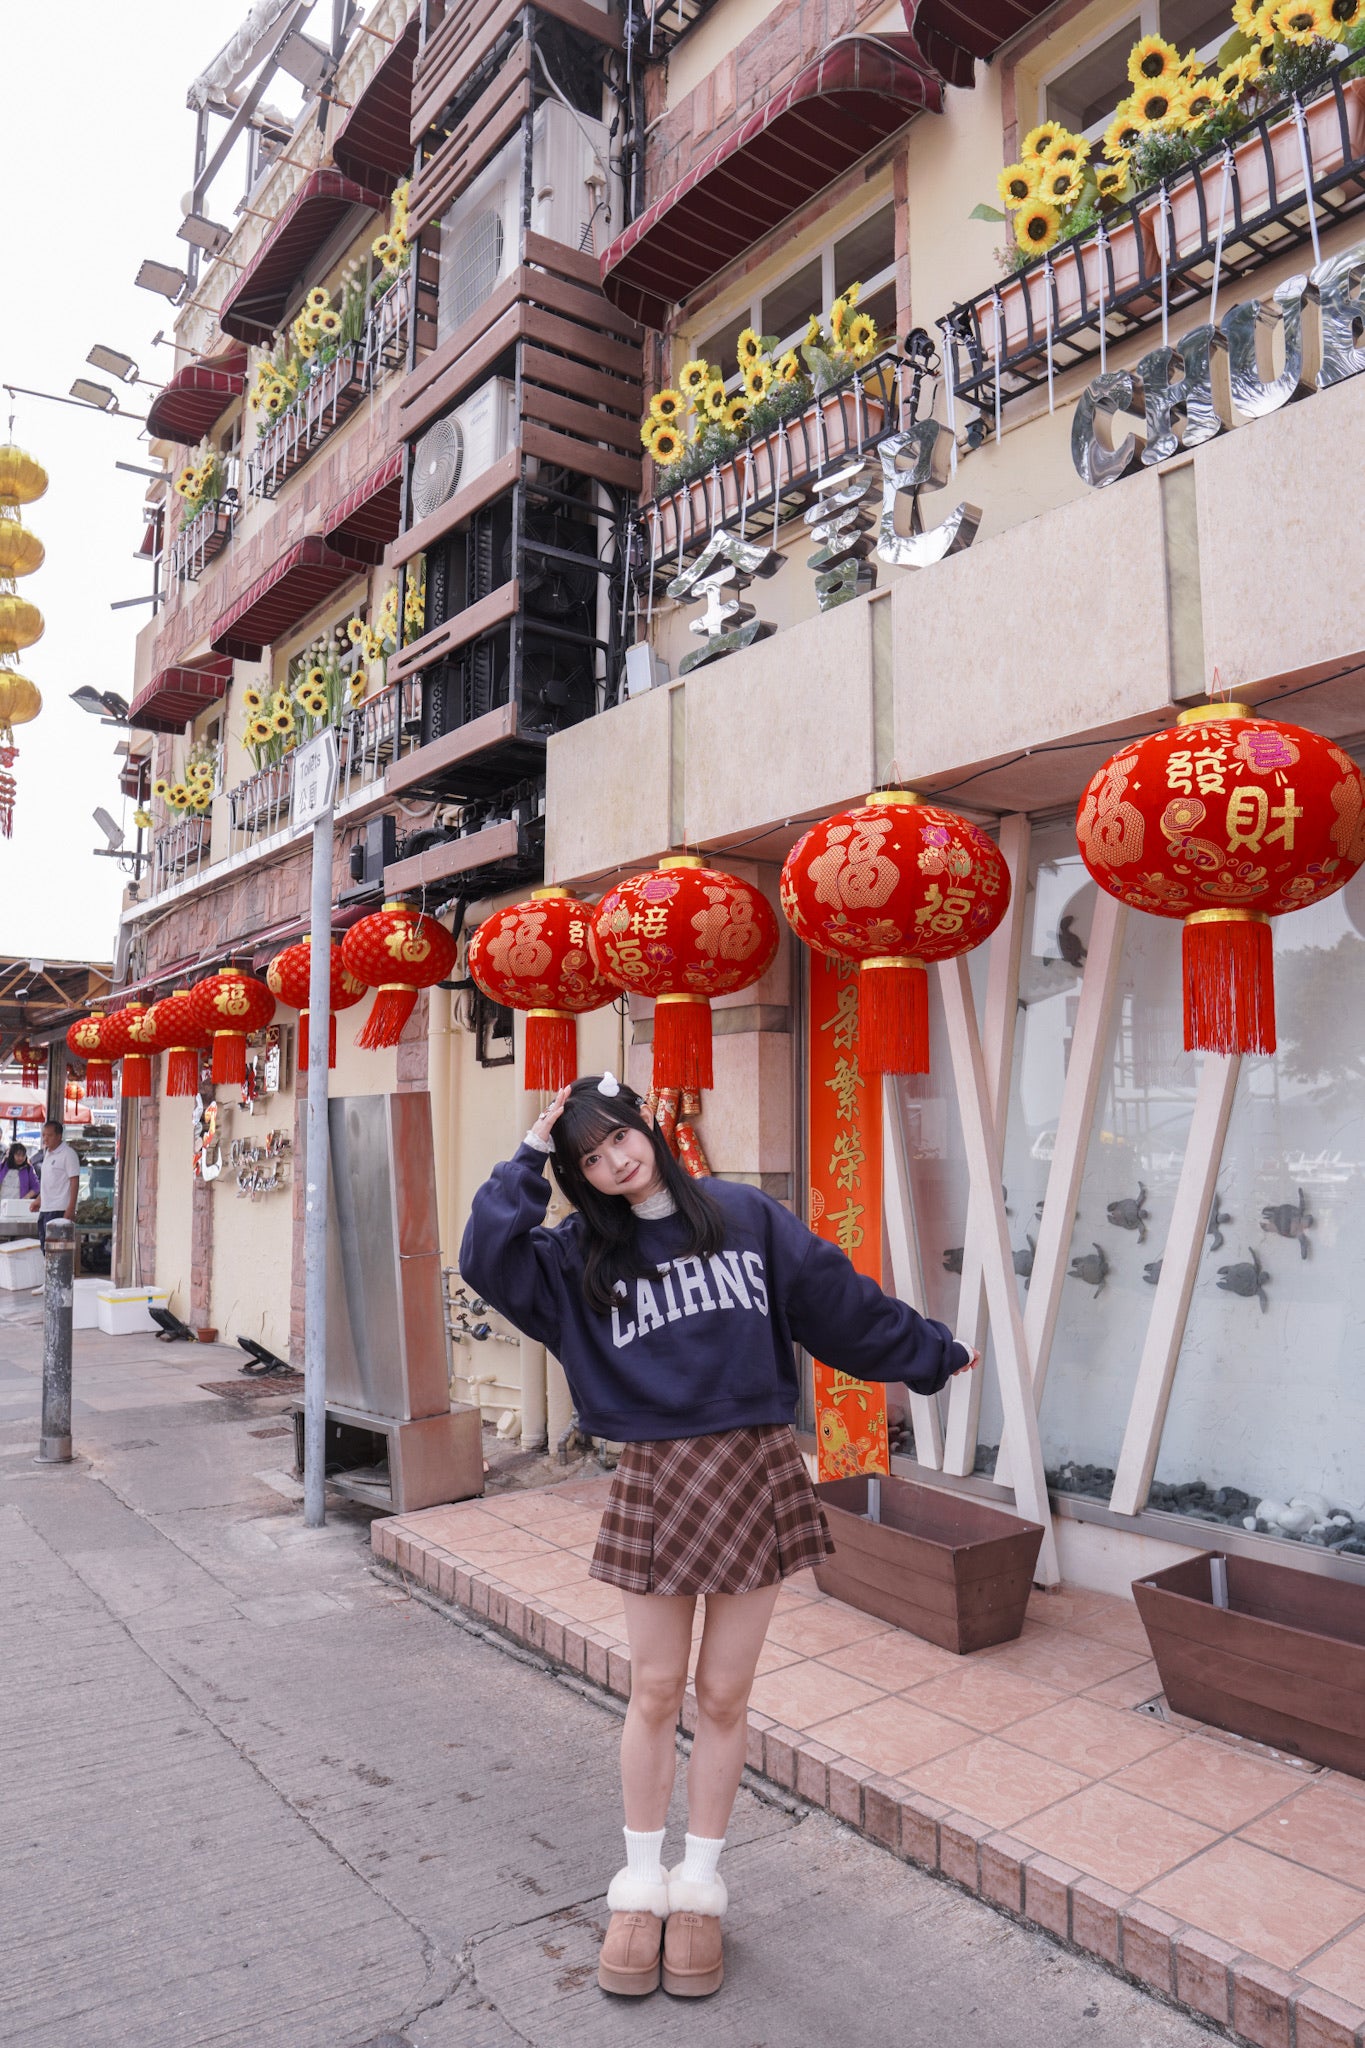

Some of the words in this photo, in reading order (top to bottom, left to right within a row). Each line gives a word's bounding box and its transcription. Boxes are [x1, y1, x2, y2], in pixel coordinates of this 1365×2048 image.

[1225, 785, 1304, 854] 財
[807, 817, 901, 912] 福
[630, 905, 669, 940] 接
[690, 885, 763, 962] 福
[914, 883, 977, 935] 福
[486, 911, 553, 978] 福
[604, 938, 650, 978] 福
[213, 983, 251, 1016] 福
[74, 1023, 101, 1049] 福
[611, 1250, 769, 1349] CAIRNS
